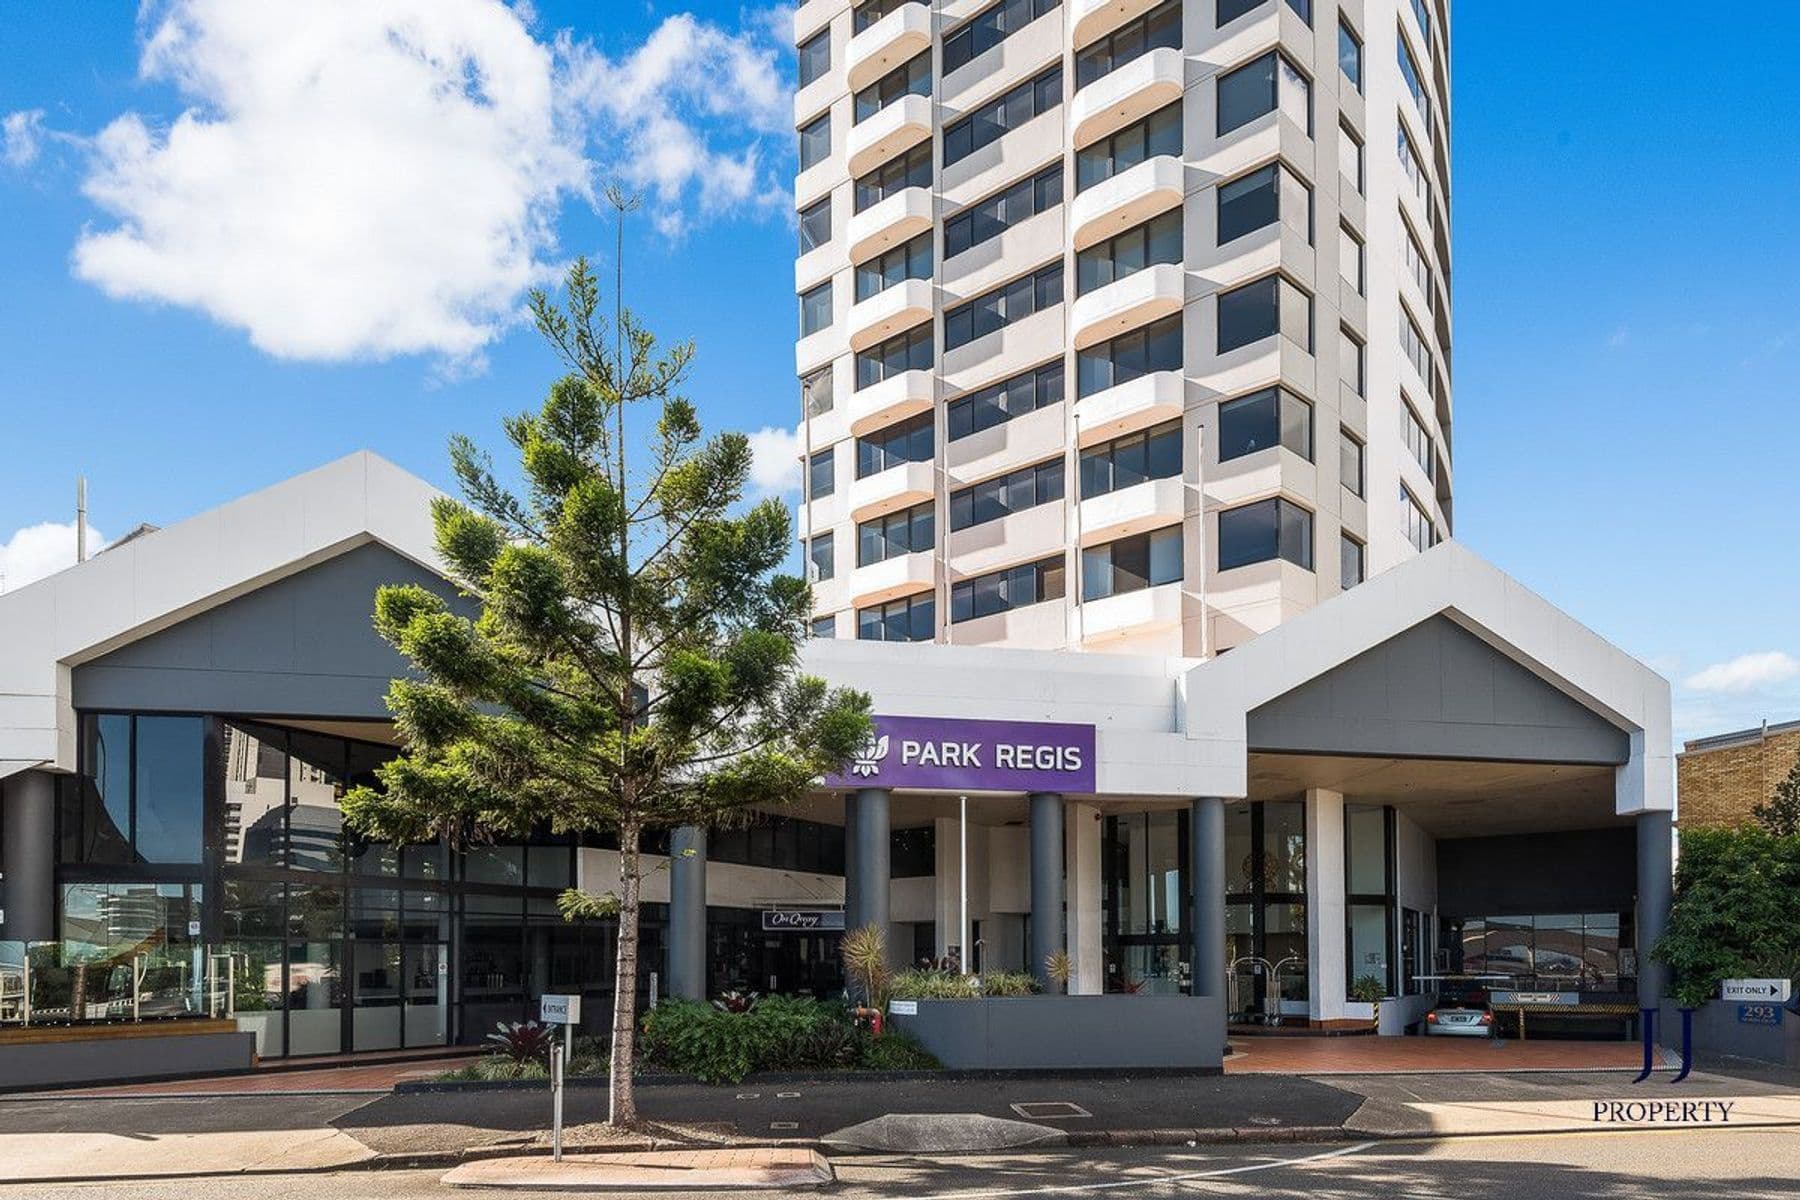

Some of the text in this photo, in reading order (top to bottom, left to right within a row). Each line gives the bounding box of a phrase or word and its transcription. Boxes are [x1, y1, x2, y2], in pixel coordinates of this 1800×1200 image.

[902, 740, 1083, 771] PARK REGIS
[1727, 986, 1767, 994] EXIT ONLY
[1745, 1006, 1774, 1017] 293
